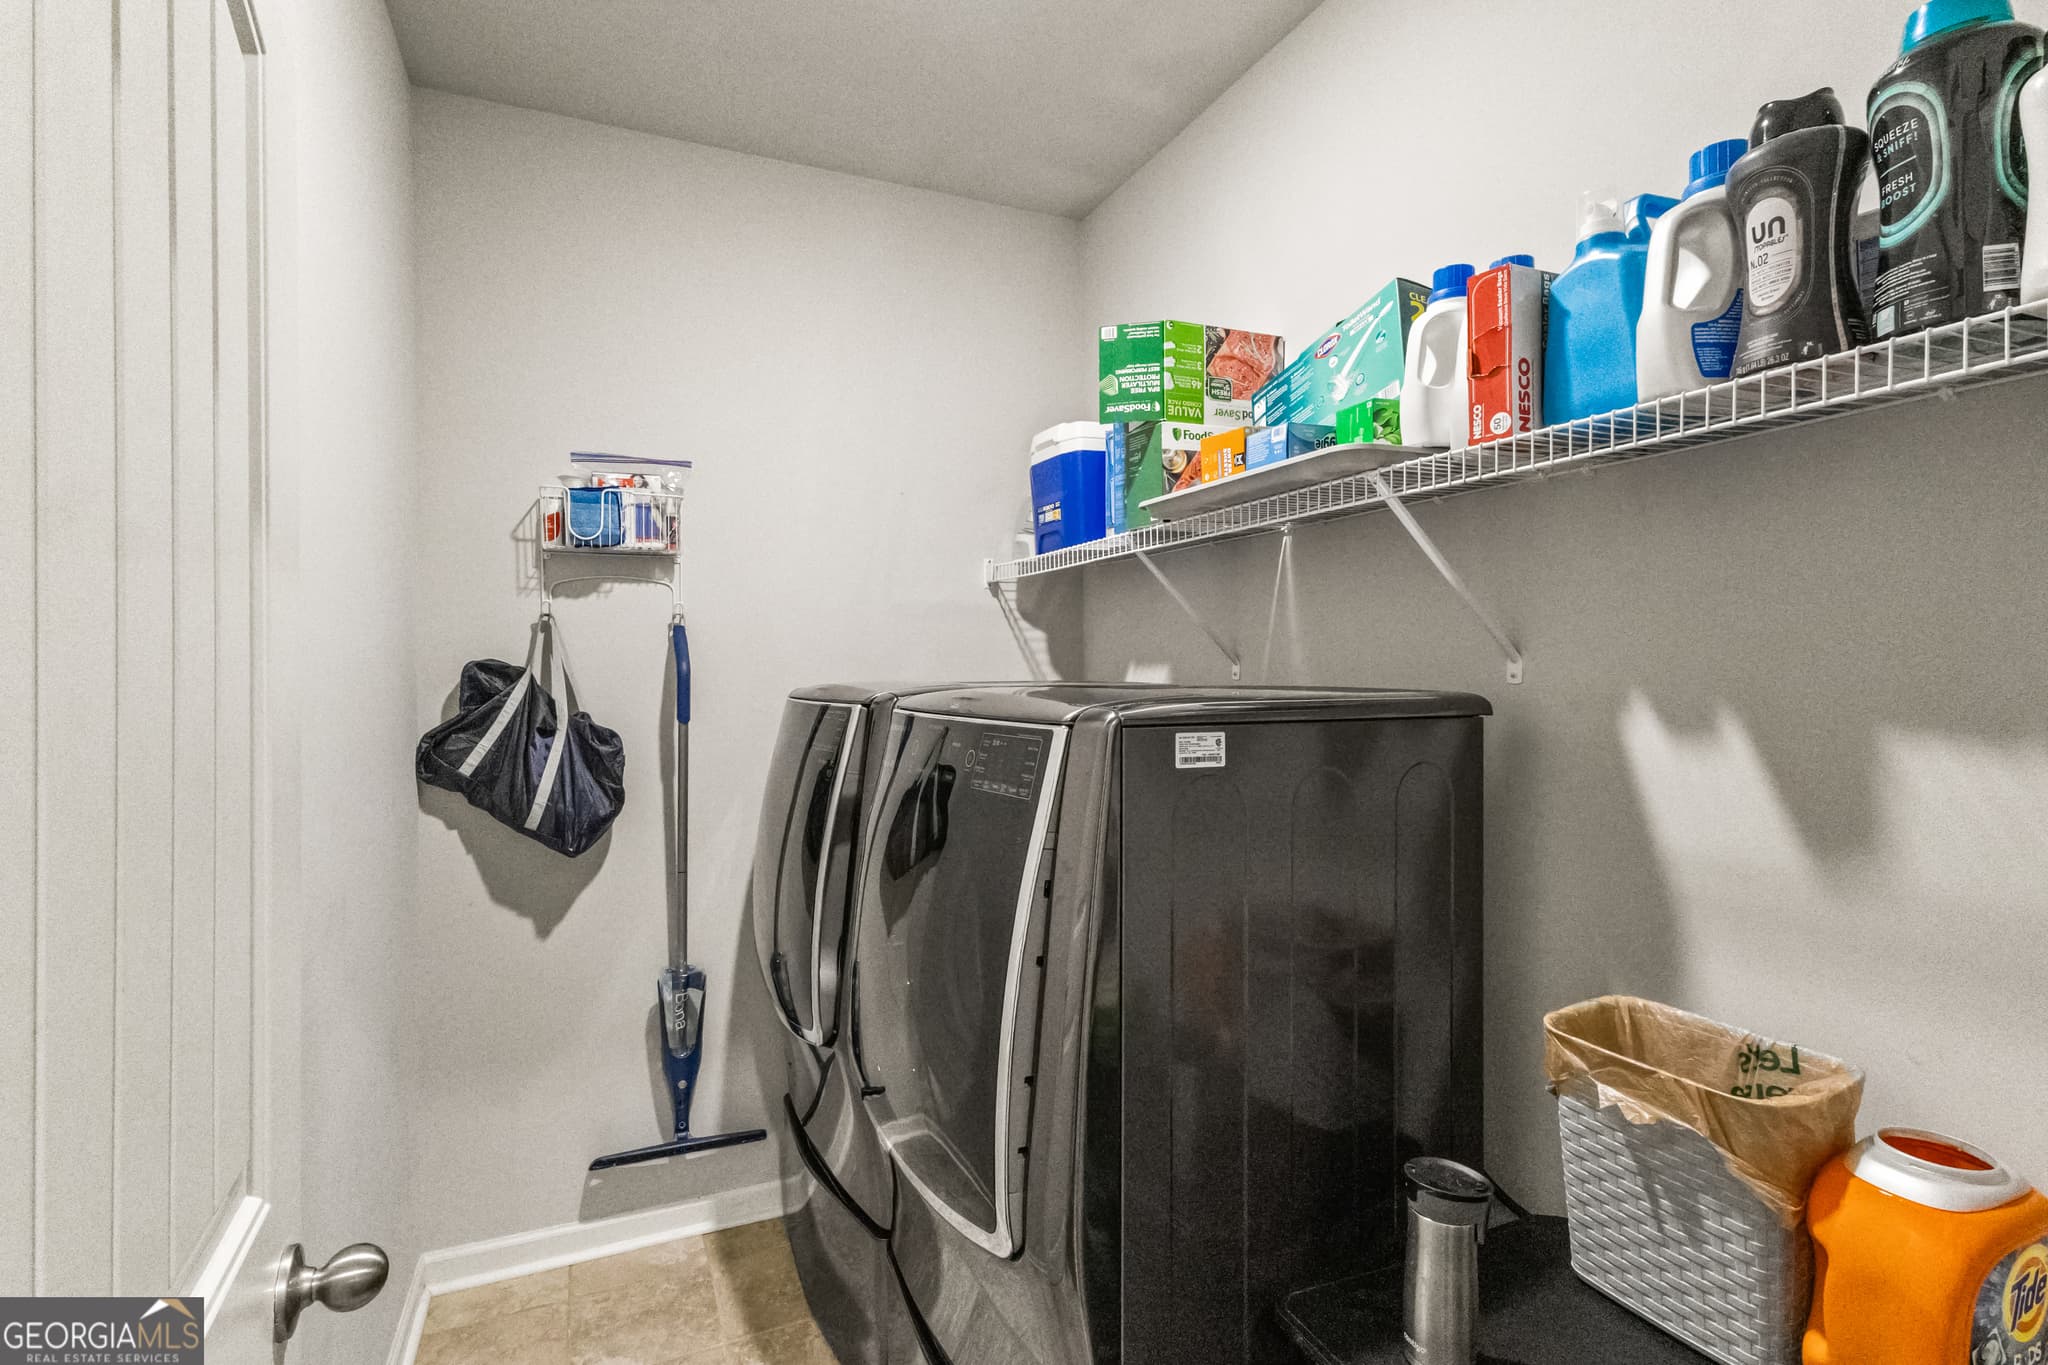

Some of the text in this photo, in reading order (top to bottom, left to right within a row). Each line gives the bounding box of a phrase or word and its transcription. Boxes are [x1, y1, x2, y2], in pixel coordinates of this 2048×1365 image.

[1874, 118, 1919, 153] SQUEEZE
[1883, 132, 1918, 159] SNIFF!
[1881, 172, 1913, 197] FRESH
[1881, 183, 1916, 209] BOOST
[1750, 253, 1769, 269] N.02
[1409, 291, 1427, 304] CLE
[1119, 373, 1160, 382] PROTECTION
[1518, 357, 1531, 432] NESCO
[1104, 402, 1151, 413] FoodSaver
[1168, 405, 1203, 418] VALUE
[1214, 405, 1253, 421] odSaver
[1473, 404, 1482, 439] NESCO
[1494, 417, 1501, 431] 50
[1183, 429, 1214, 441] FoodS
[1315, 436, 1336, 449] ggle
[675, 992, 688, 1031] Bona
[2011, 1268, 2047, 1333] Tide
